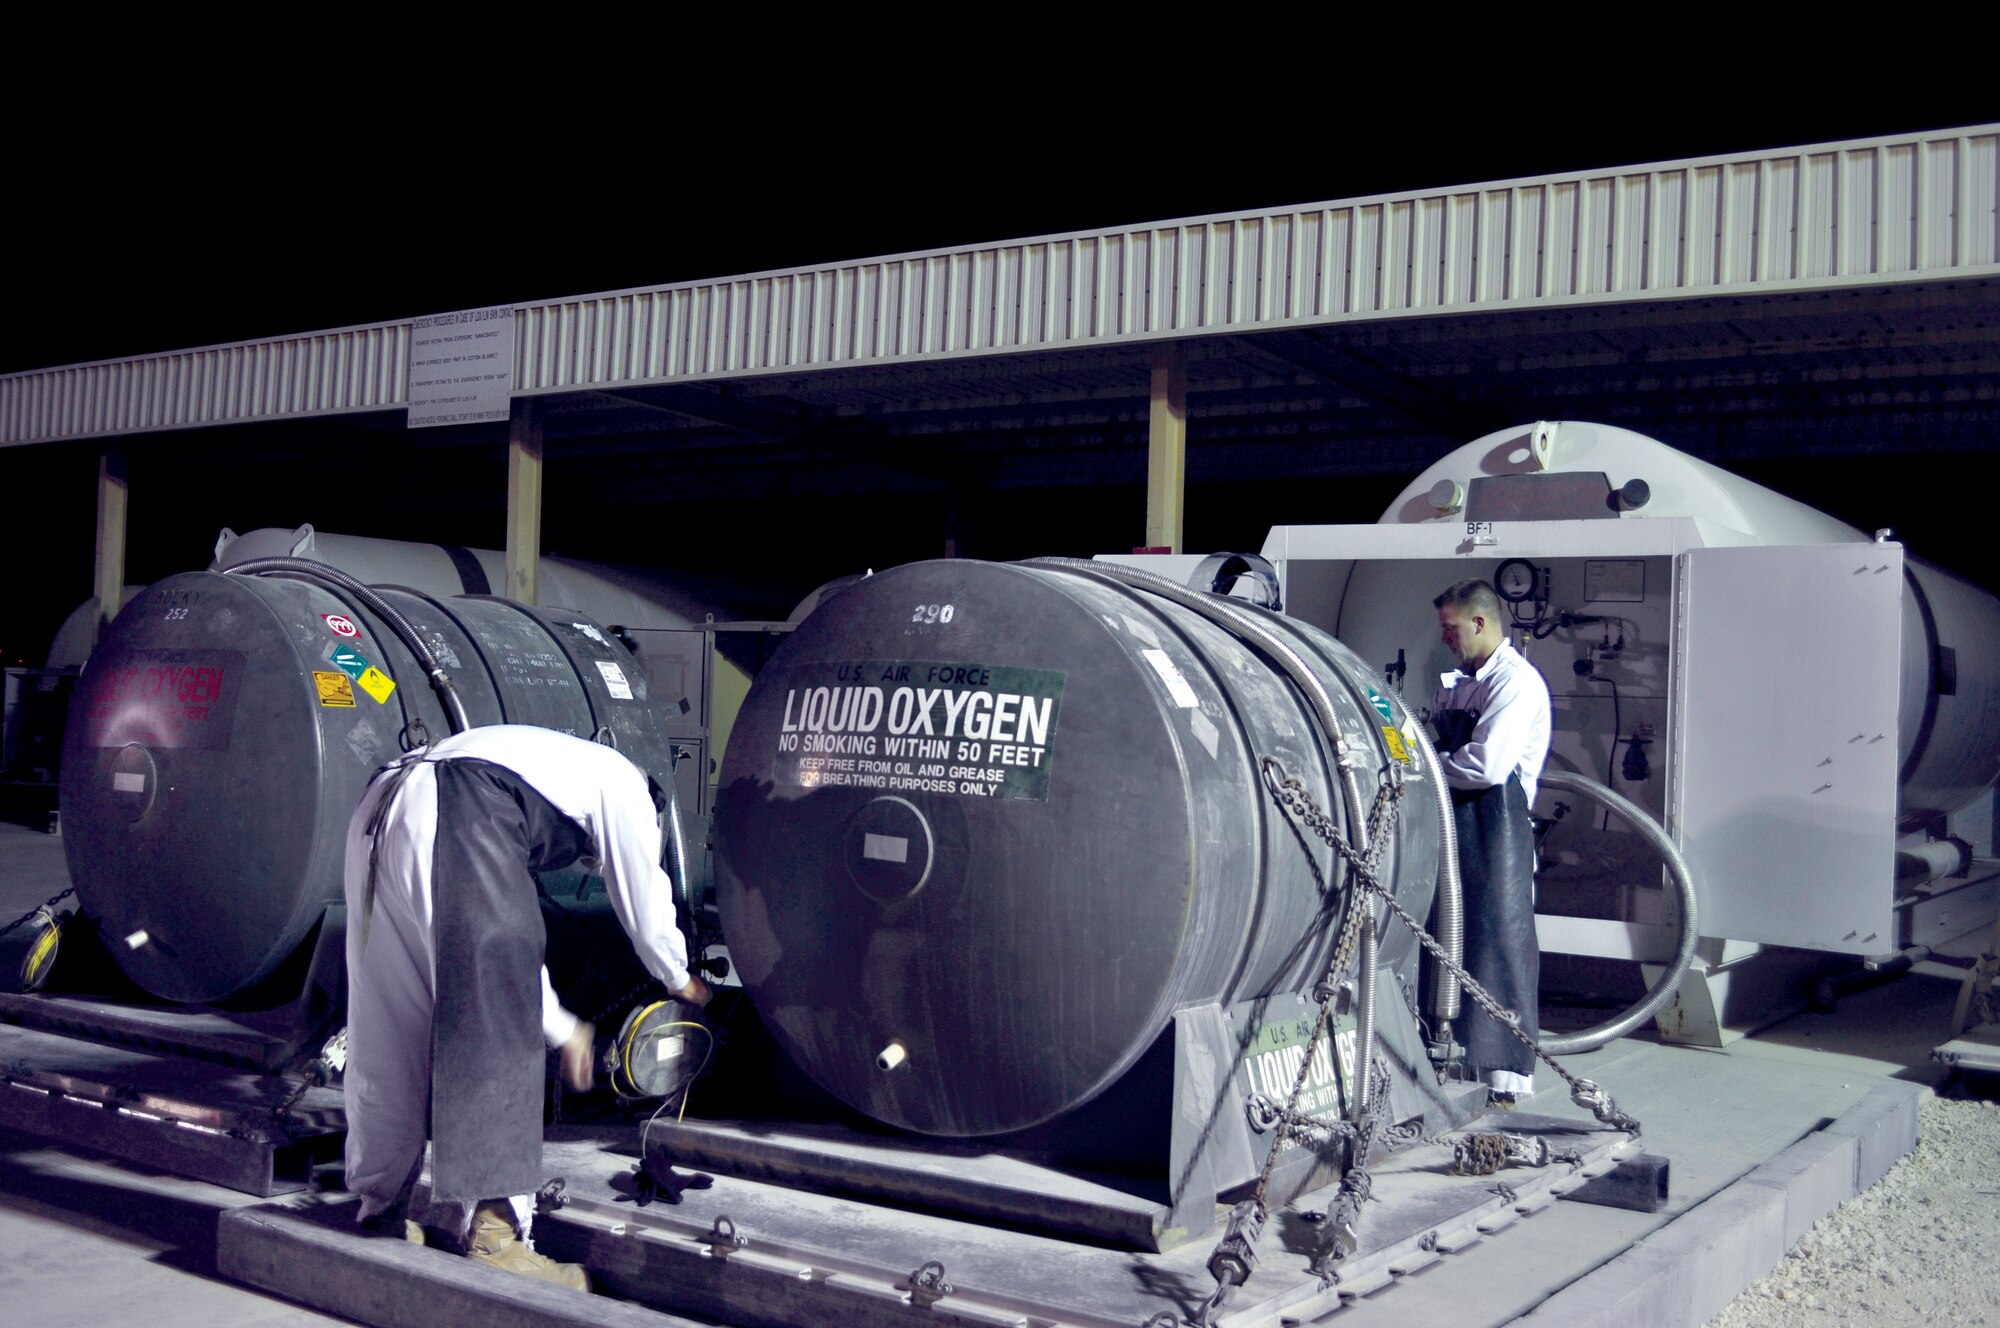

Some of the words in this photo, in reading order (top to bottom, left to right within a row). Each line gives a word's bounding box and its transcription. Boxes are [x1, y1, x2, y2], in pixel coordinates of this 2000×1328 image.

[460, 312, 469, 323] CASE
[1467, 523, 1492, 534] BF-1
[164, 608, 189, 620] 252
[912, 604, 955, 625] 290
[330, 620, 352, 631] 999
[837, 665, 864, 682] U.S.
[881, 665, 910, 683] AIR
[928, 666, 990, 686] FORCE
[781, 686, 884, 736] LIQUID
[888, 686, 1052, 746] OXYGEN
[778, 734, 799, 752] NO
[803, 734, 876, 756] SMOKING
[885, 737, 950, 760] WITHIN
[957, 741, 982, 762] 50
[988, 744, 1046, 767] FEET
[799, 757, 825, 770] KEEP
[827, 758, 855, 771] FREE
[858, 759, 891, 774] FROM
[895, 762, 914, 776] OIL
[918, 763, 945, 778] AND
[949, 766, 1005, 782] GREASE
[799, 771, 820, 784] FOR
[822, 773, 886, 789] BREATHING
[889, 776, 956, 794] PURPOSES
[960, 781, 998, 797] ONLY
[1270, 1025, 1289, 1045] U.S.
[1296, 1020, 1311, 1039] AIR
